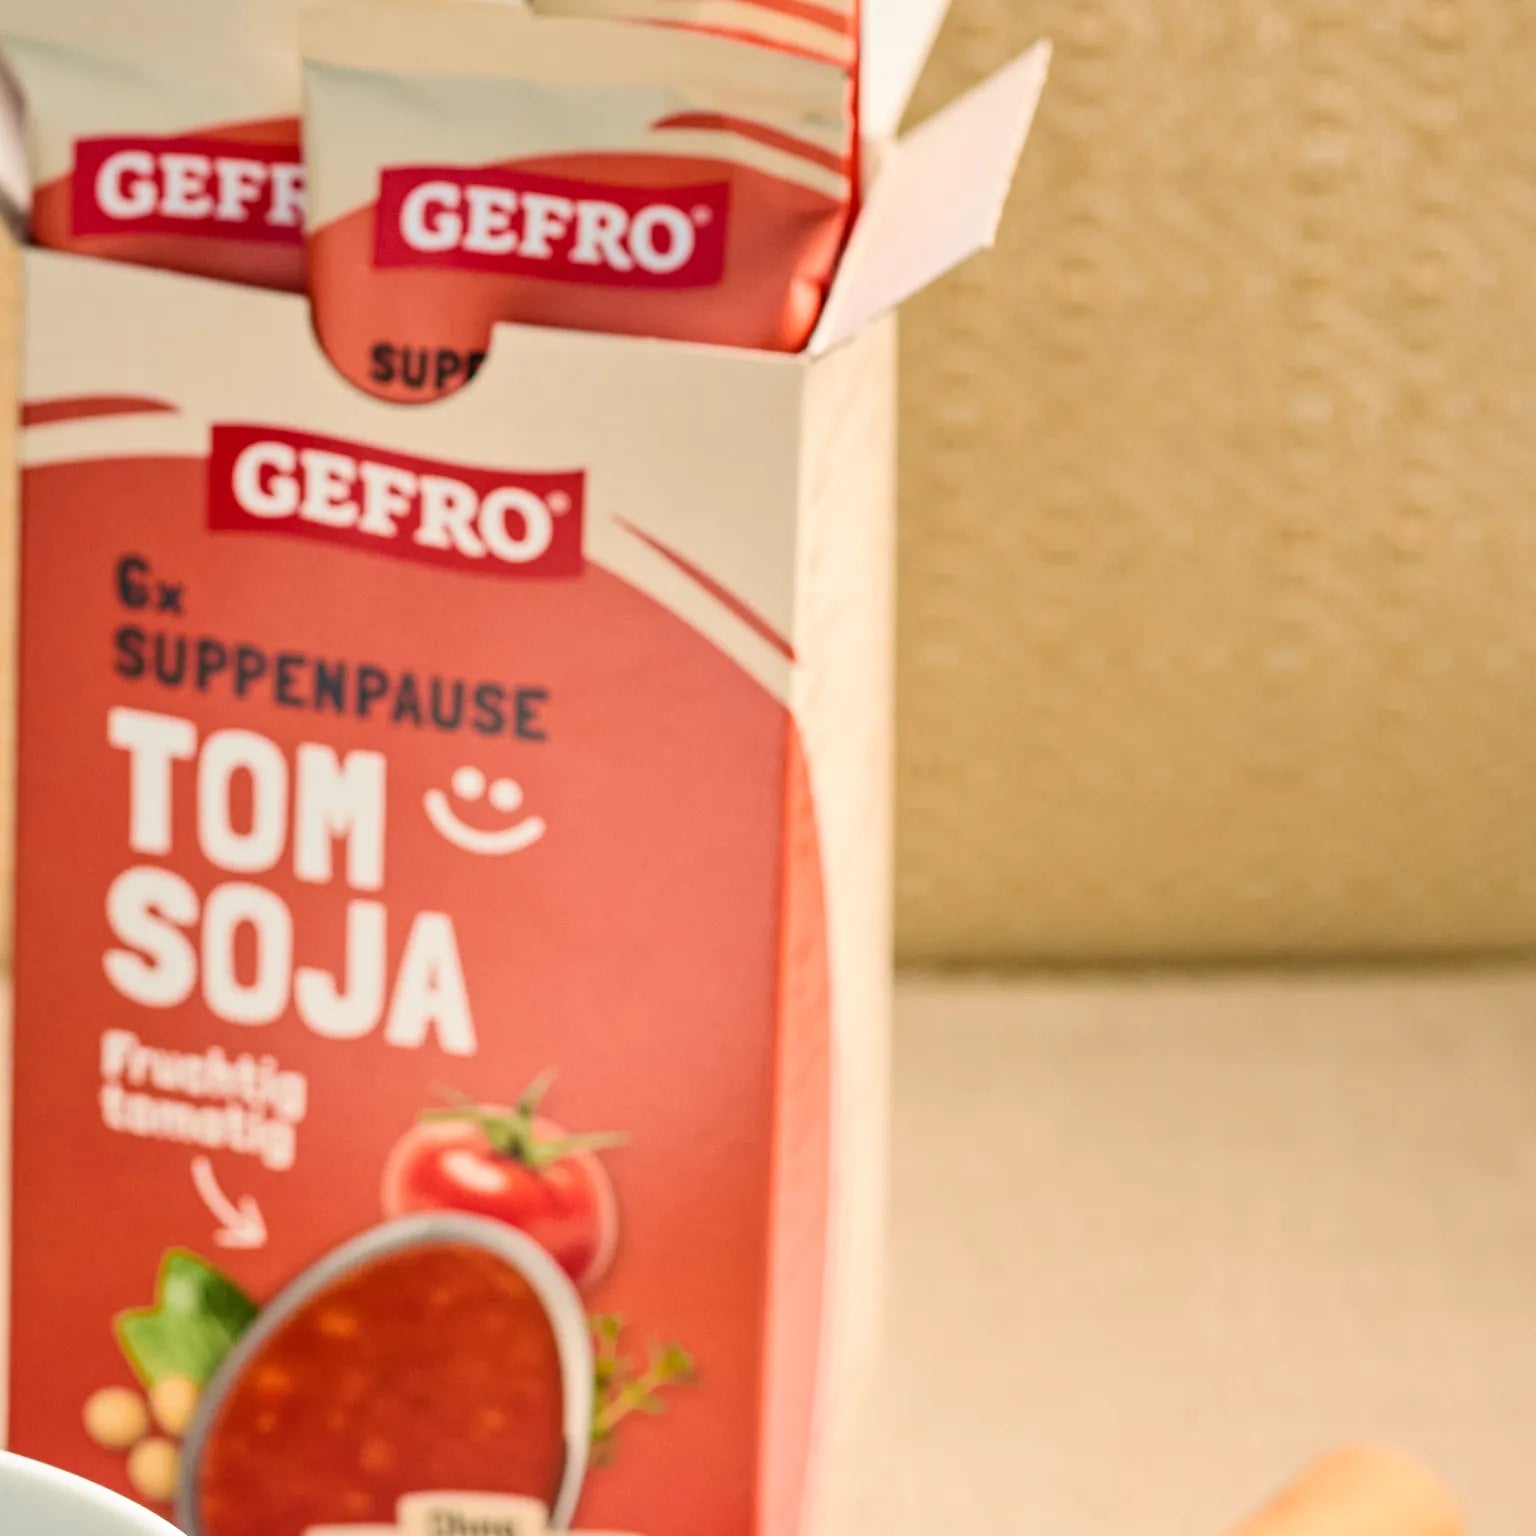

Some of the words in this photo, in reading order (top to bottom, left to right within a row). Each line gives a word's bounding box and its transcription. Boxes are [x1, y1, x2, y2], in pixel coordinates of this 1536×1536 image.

[114, 553, 185, 616] 6x
[113, 626, 551, 742] SUPPENPAUSE
[107, 706, 387, 891] TOM
[102, 865, 478, 1056] SOJA
